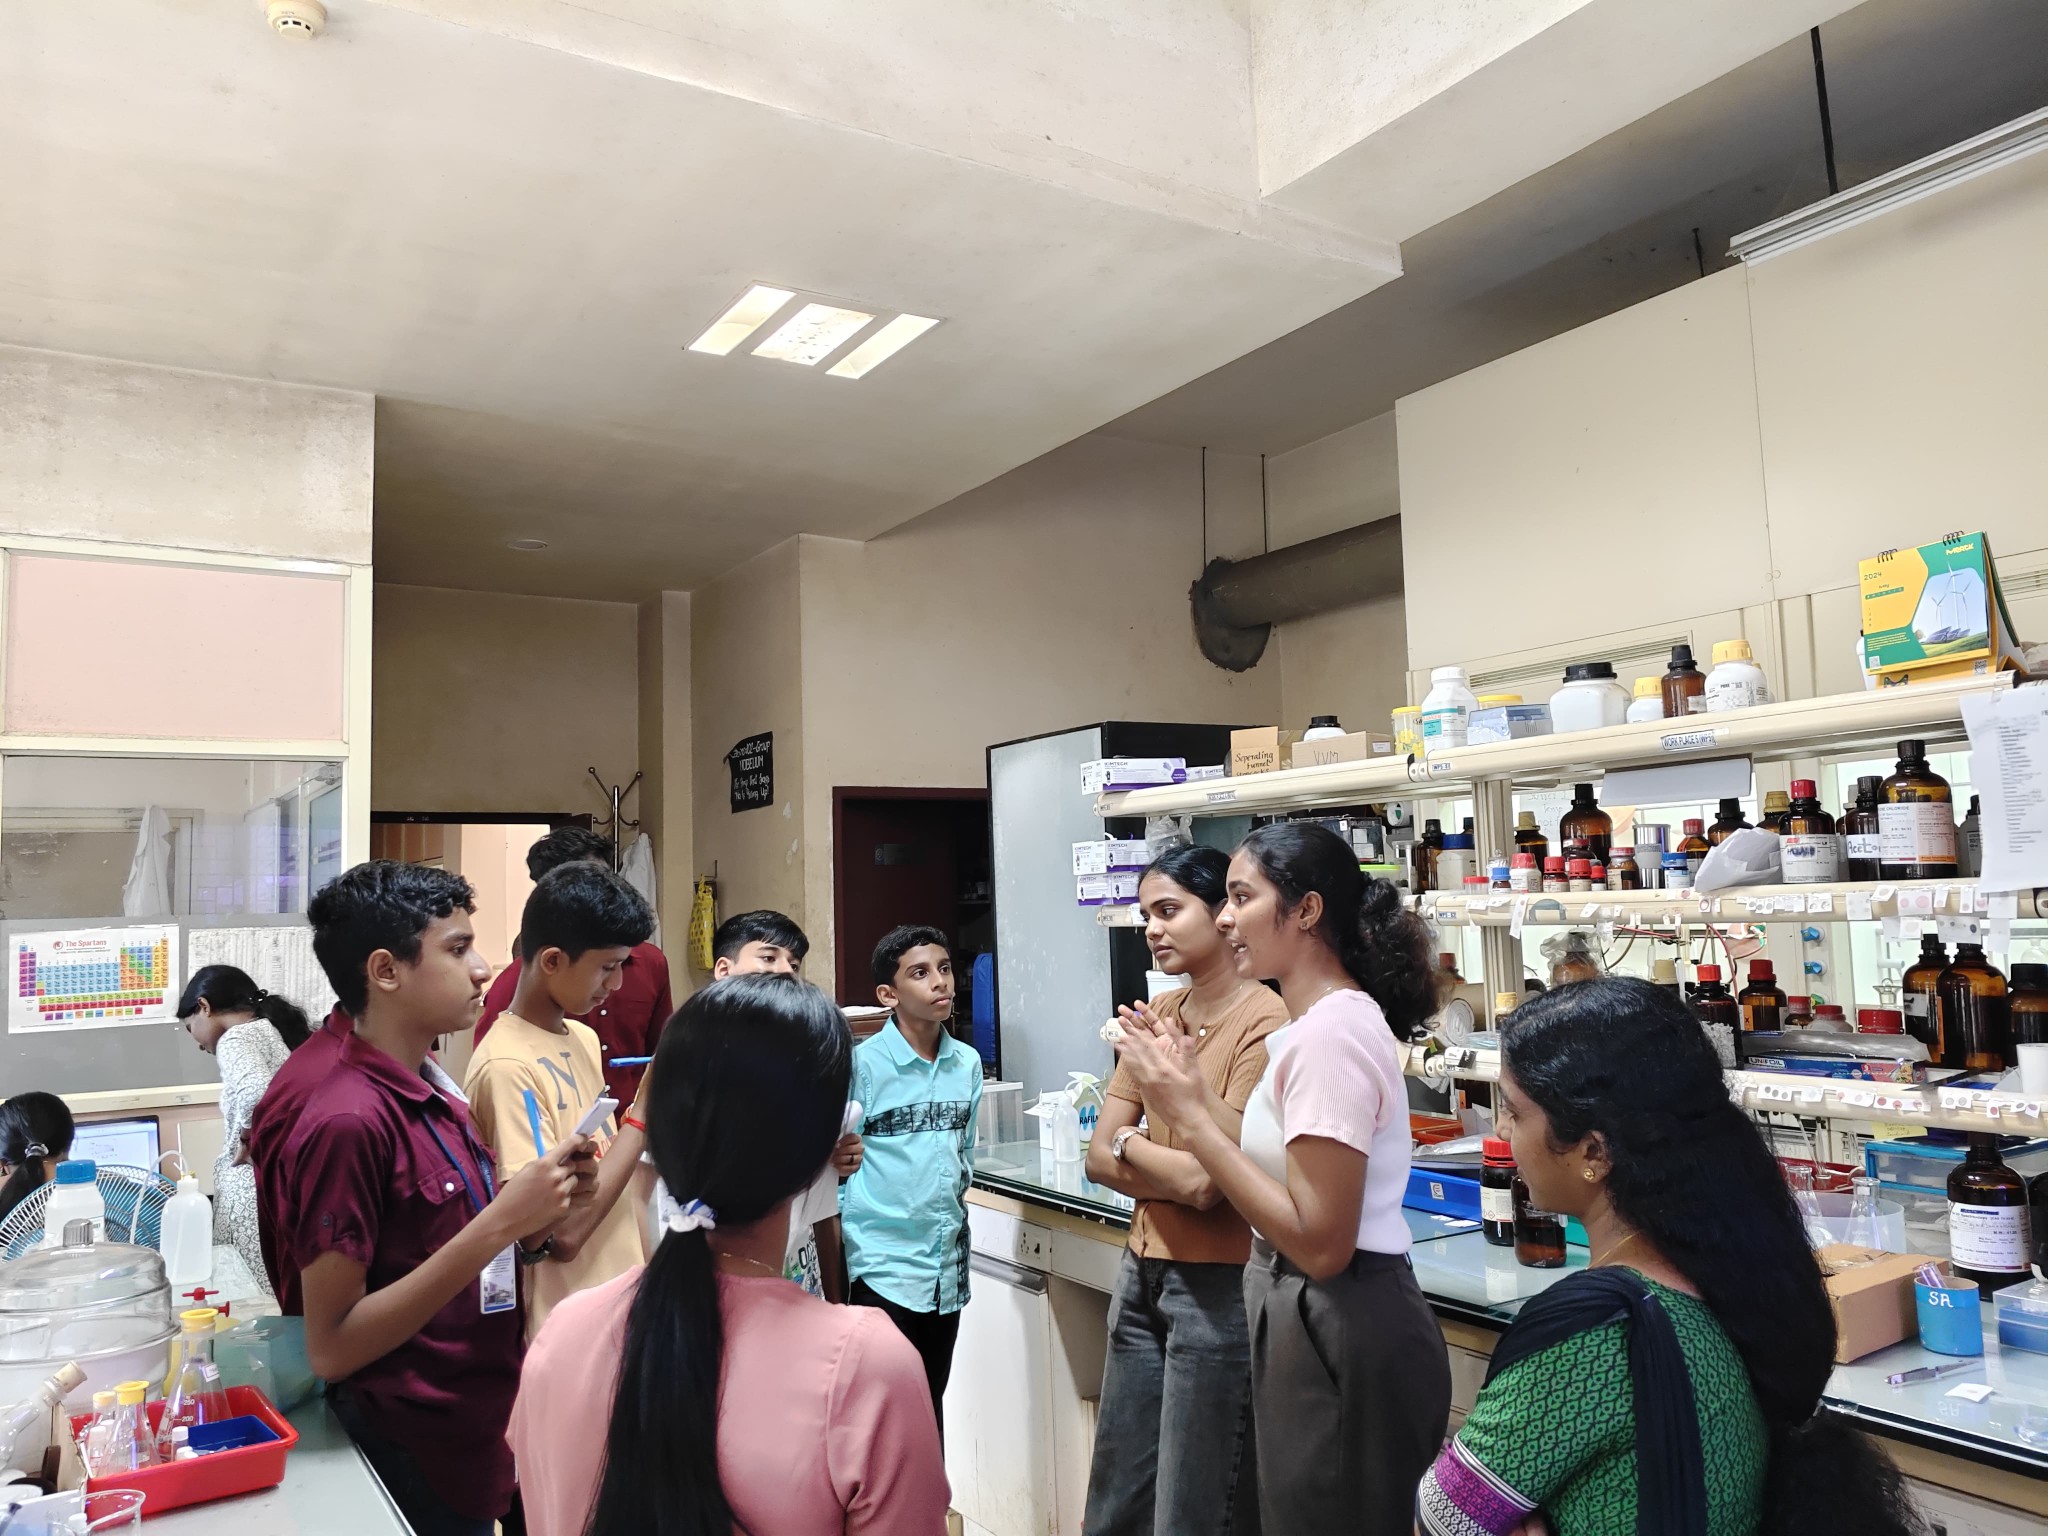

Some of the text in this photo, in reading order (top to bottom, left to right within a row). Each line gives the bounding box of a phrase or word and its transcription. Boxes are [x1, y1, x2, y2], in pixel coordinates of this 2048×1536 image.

[1864, 572, 1882, 580] 2024
[1664, 735, 1679, 746] WORK
[1678, 735, 1695, 745] PLACE
[1235, 751, 1273, 763] Seperating
[1848, 838, 1881, 855] Aceto
[1080, 1115, 1099, 1125] RAFIL
